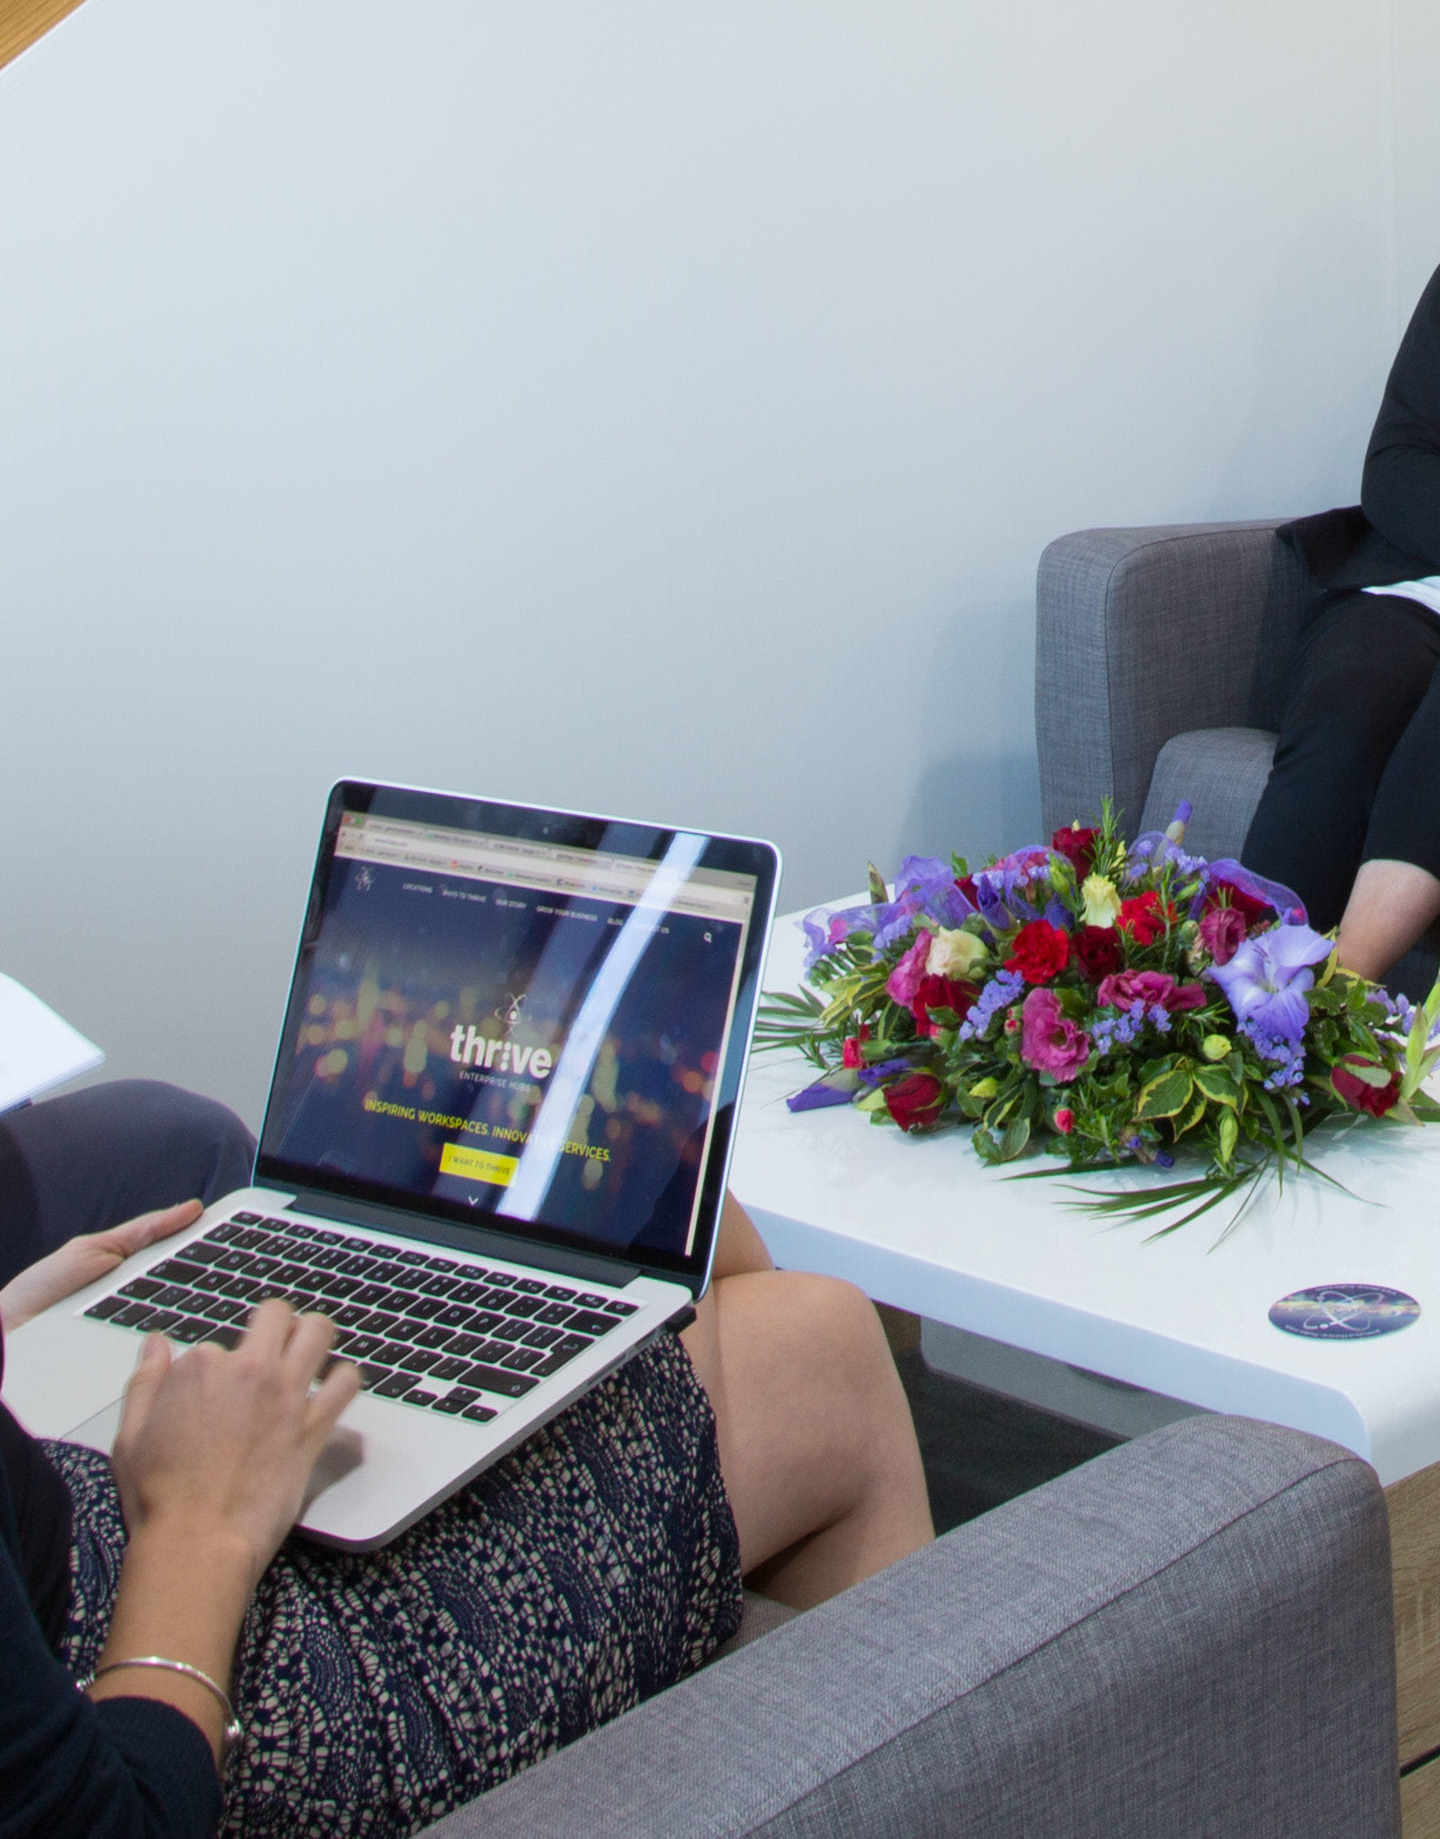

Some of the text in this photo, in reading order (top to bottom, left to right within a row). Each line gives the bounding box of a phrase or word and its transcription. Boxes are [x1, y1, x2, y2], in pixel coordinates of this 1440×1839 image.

[449, 1023, 553, 1080] thrive
[459, 1069, 531, 1094] ENTERPRISE HUBS
[364, 1098, 416, 1121] INSPIRING
